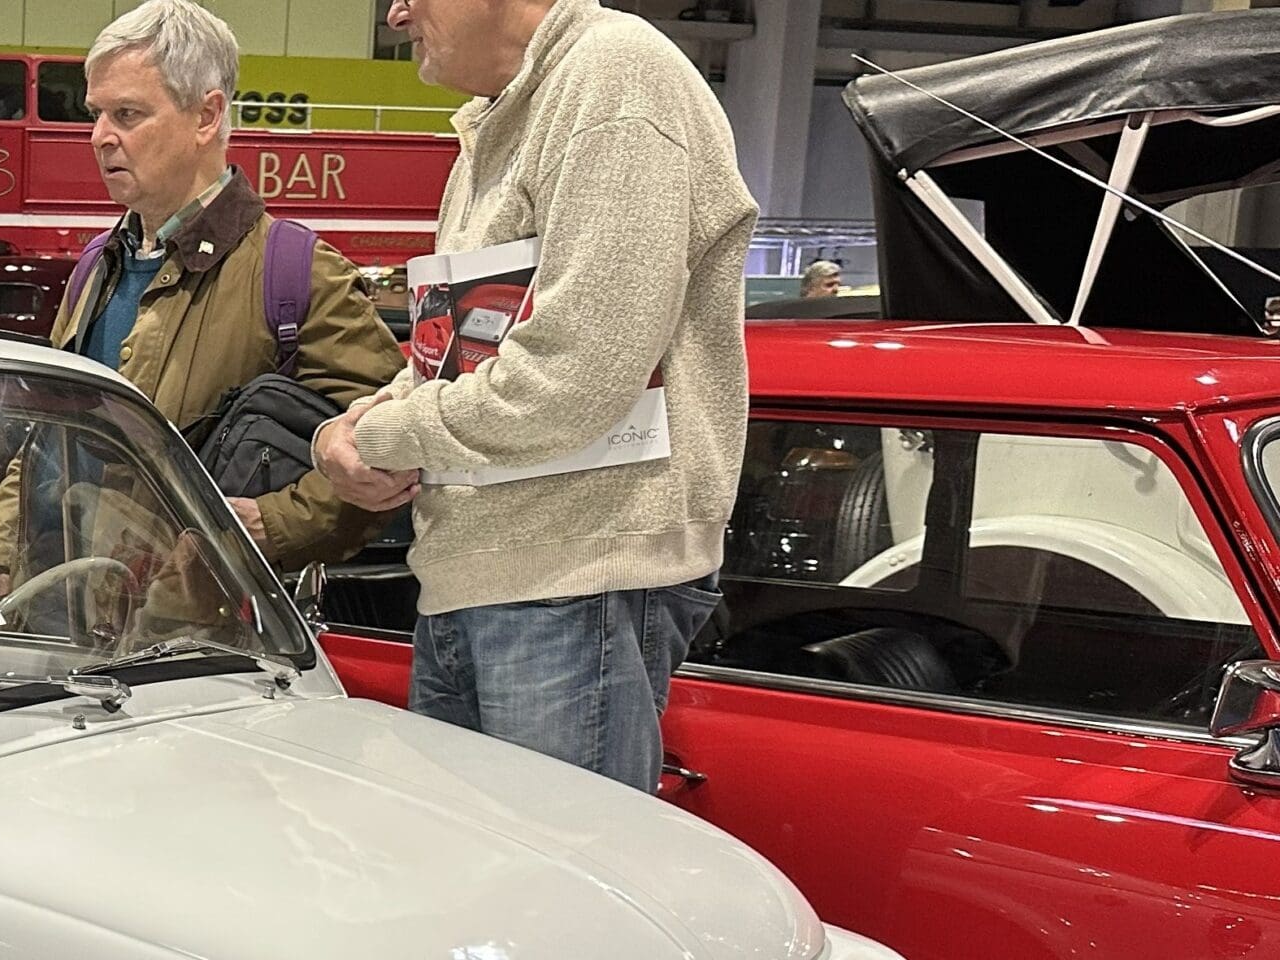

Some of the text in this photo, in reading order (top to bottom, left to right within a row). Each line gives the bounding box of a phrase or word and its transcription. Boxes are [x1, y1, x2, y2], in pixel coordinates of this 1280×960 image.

[234, 91, 309, 124] ess
[259, 152, 346, 200] BAR
[608, 427, 658, 446] ICONIC
